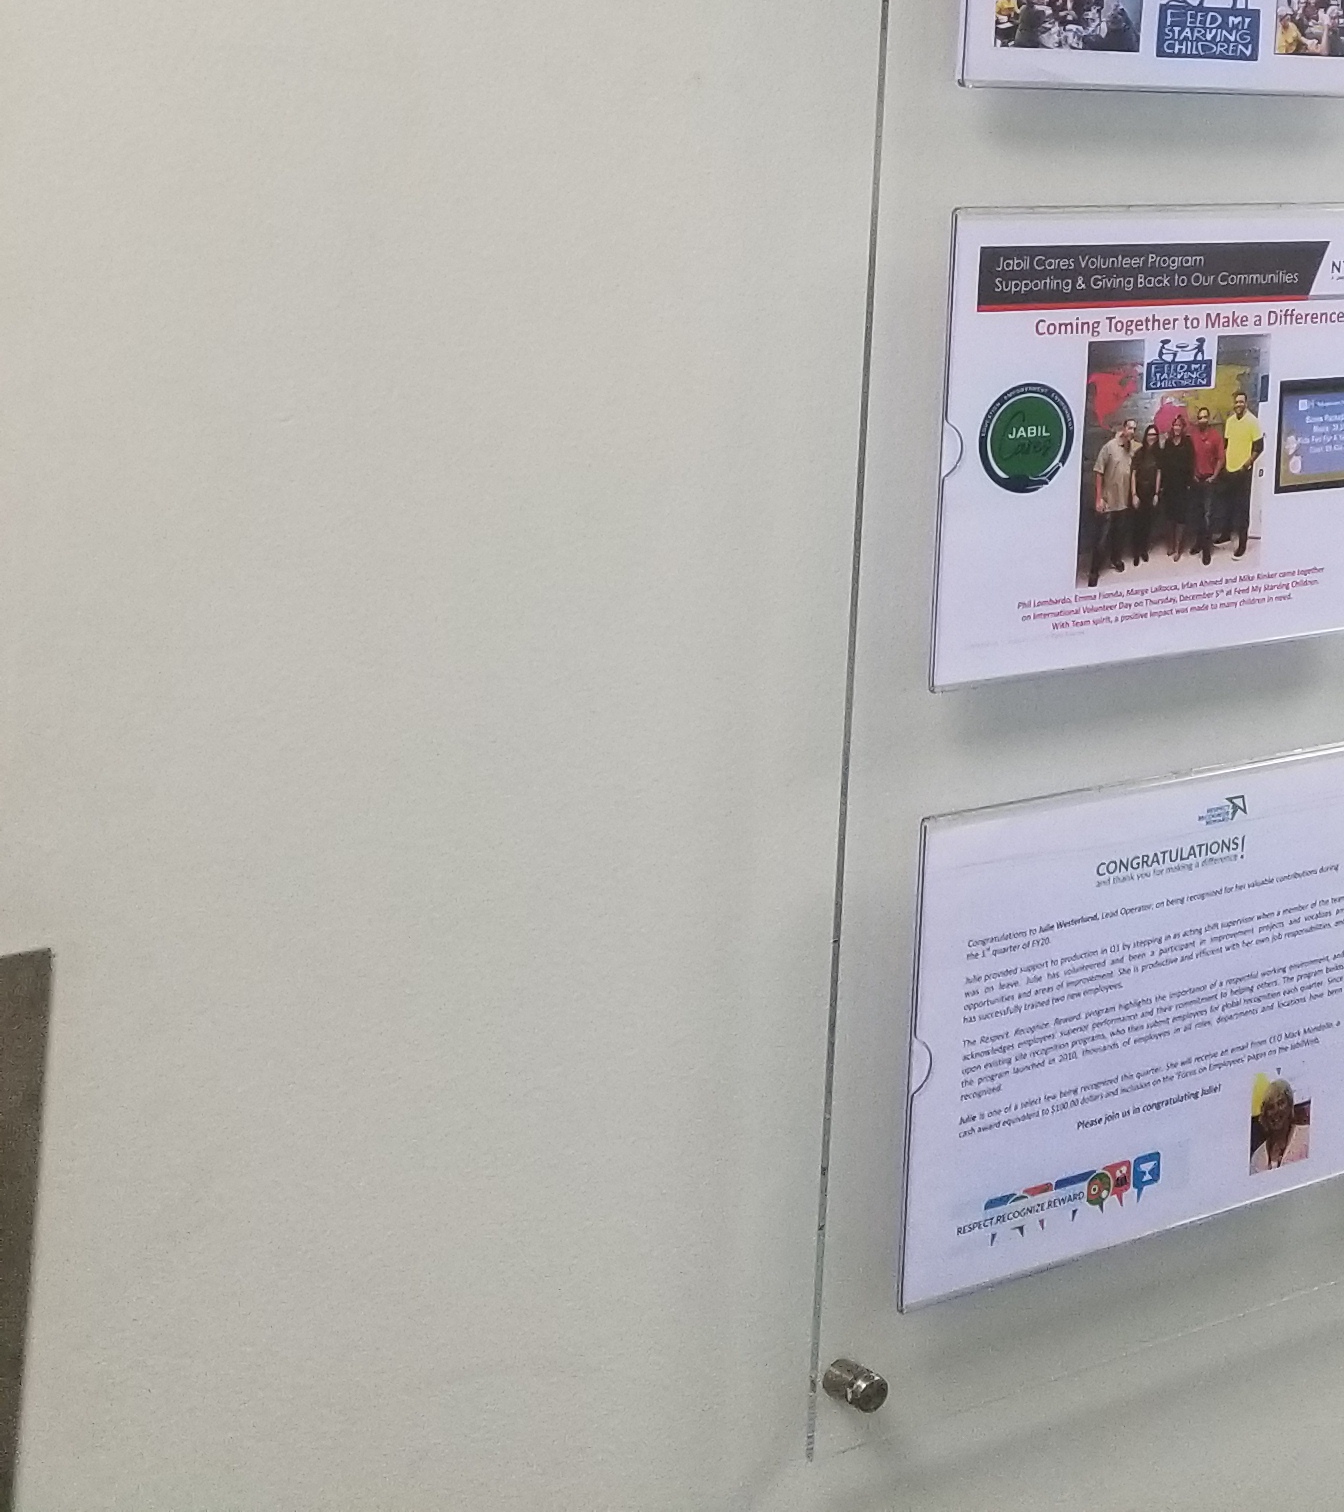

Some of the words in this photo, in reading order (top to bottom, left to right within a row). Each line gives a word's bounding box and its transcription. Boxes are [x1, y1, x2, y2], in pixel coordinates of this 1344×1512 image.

[1166, 9, 1222, 27] FEED
[1228, 15, 1252, 29] MY
[1164, 26, 1251, 44] STARVING
[1164, 41, 1252, 57] CHILDREN
[996, 256, 1030, 271] Jabil
[1033, 255, 1075, 270] Cares
[1078, 254, 1145, 269] Volunteer
[1148, 253, 1204, 270] Program
[994, 275, 1072, 294] Supporting
[1075, 276, 1086, 290] &
[1090, 274, 1134, 291] Giving
[1137, 273, 1171, 288] Back
[1174, 273, 1188, 287] to
[1191, 272, 1215, 286] Our
[1217, 270, 1299, 286] Communities
[1035, 316, 1101, 337] Coming
[1105, 313, 1179, 336] Together
[1183, 314, 1200, 330] to
[1205, 310, 1249, 329] Make
[1253, 314, 1262, 327] a
[1008, 424, 1050, 438] JABIL
[1096, 835, 1246, 877] CONGRATULATIONS!
[1076, 1117, 1103, 1130] Please
[1104, 1111, 1120, 1125] join
[1120, 1109, 1131, 1118] us
[1132, 1106, 1141, 1115] in
[1142, 1090, 1200, 1113] congratulating
[1200, 1083, 1222, 1097] Julie!
